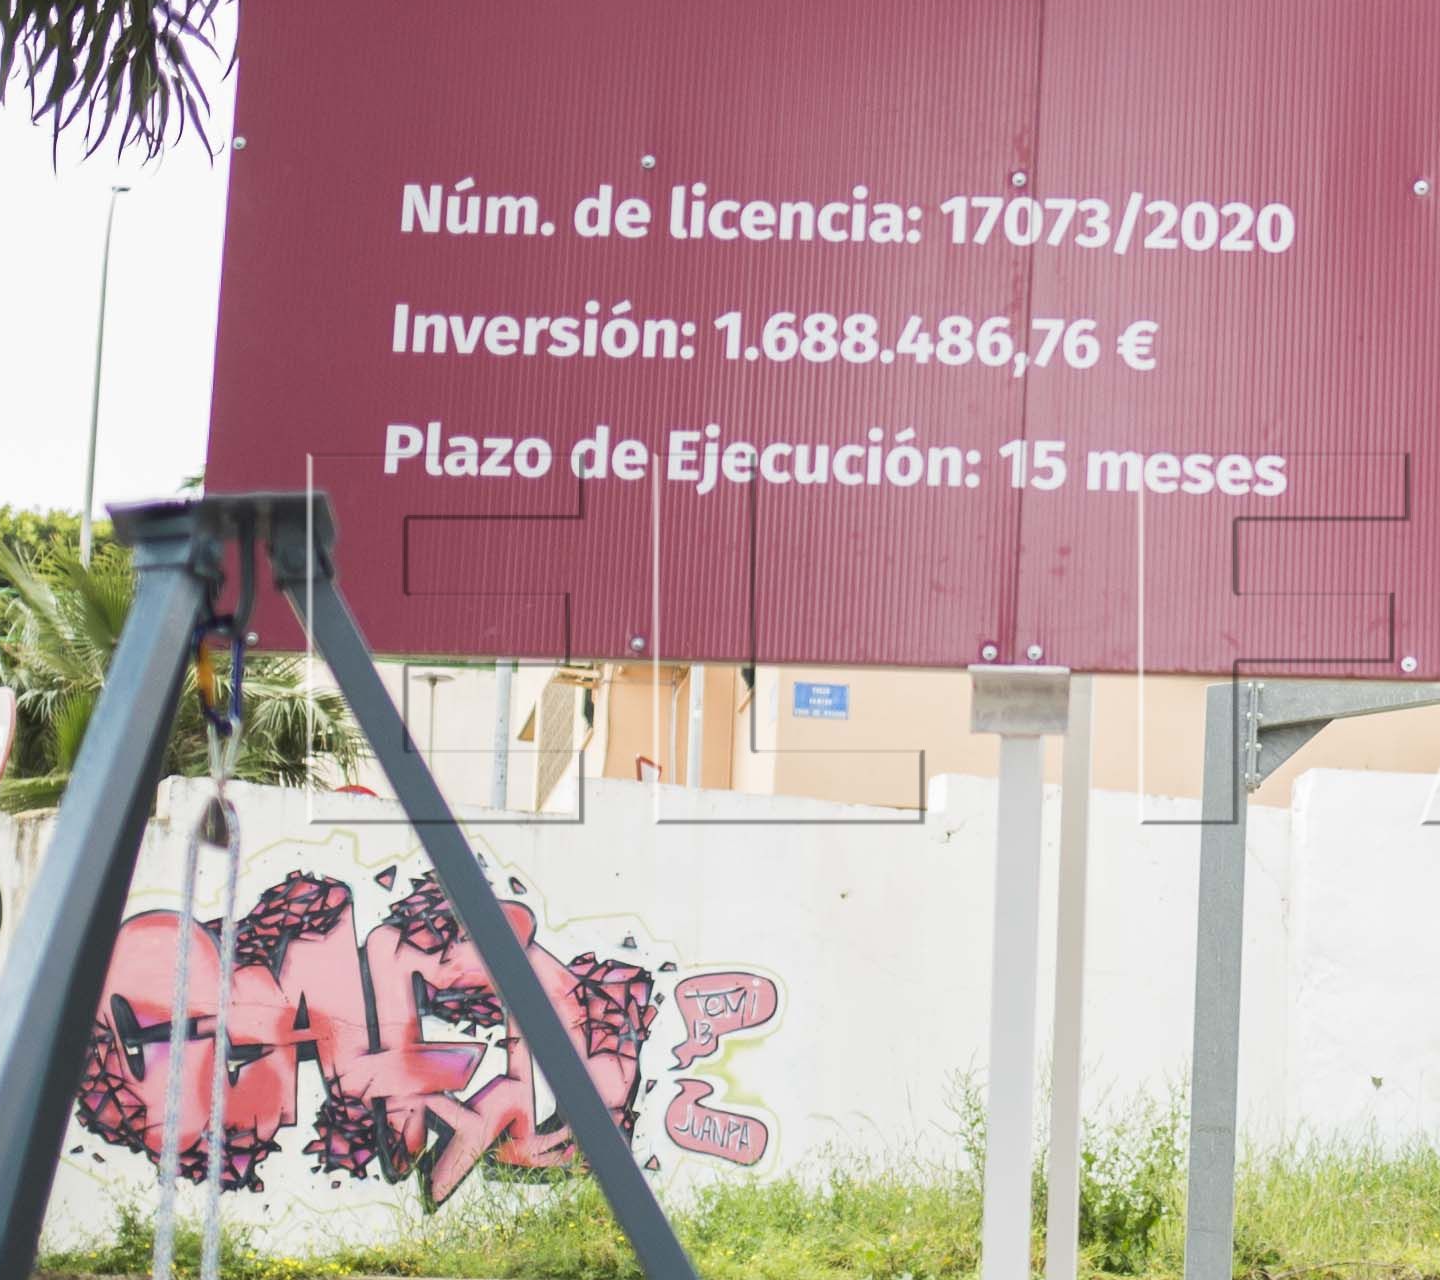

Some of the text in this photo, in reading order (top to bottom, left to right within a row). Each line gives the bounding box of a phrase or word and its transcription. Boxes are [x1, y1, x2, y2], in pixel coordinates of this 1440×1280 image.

[401, 177, 1293, 254] Núm. de licencia: 17073/2020
[393, 300, 1157, 376] Inversión: 1.688.486,76 €
[385, 422, 1285, 495] Plazo de Ejecución: 15 meses
